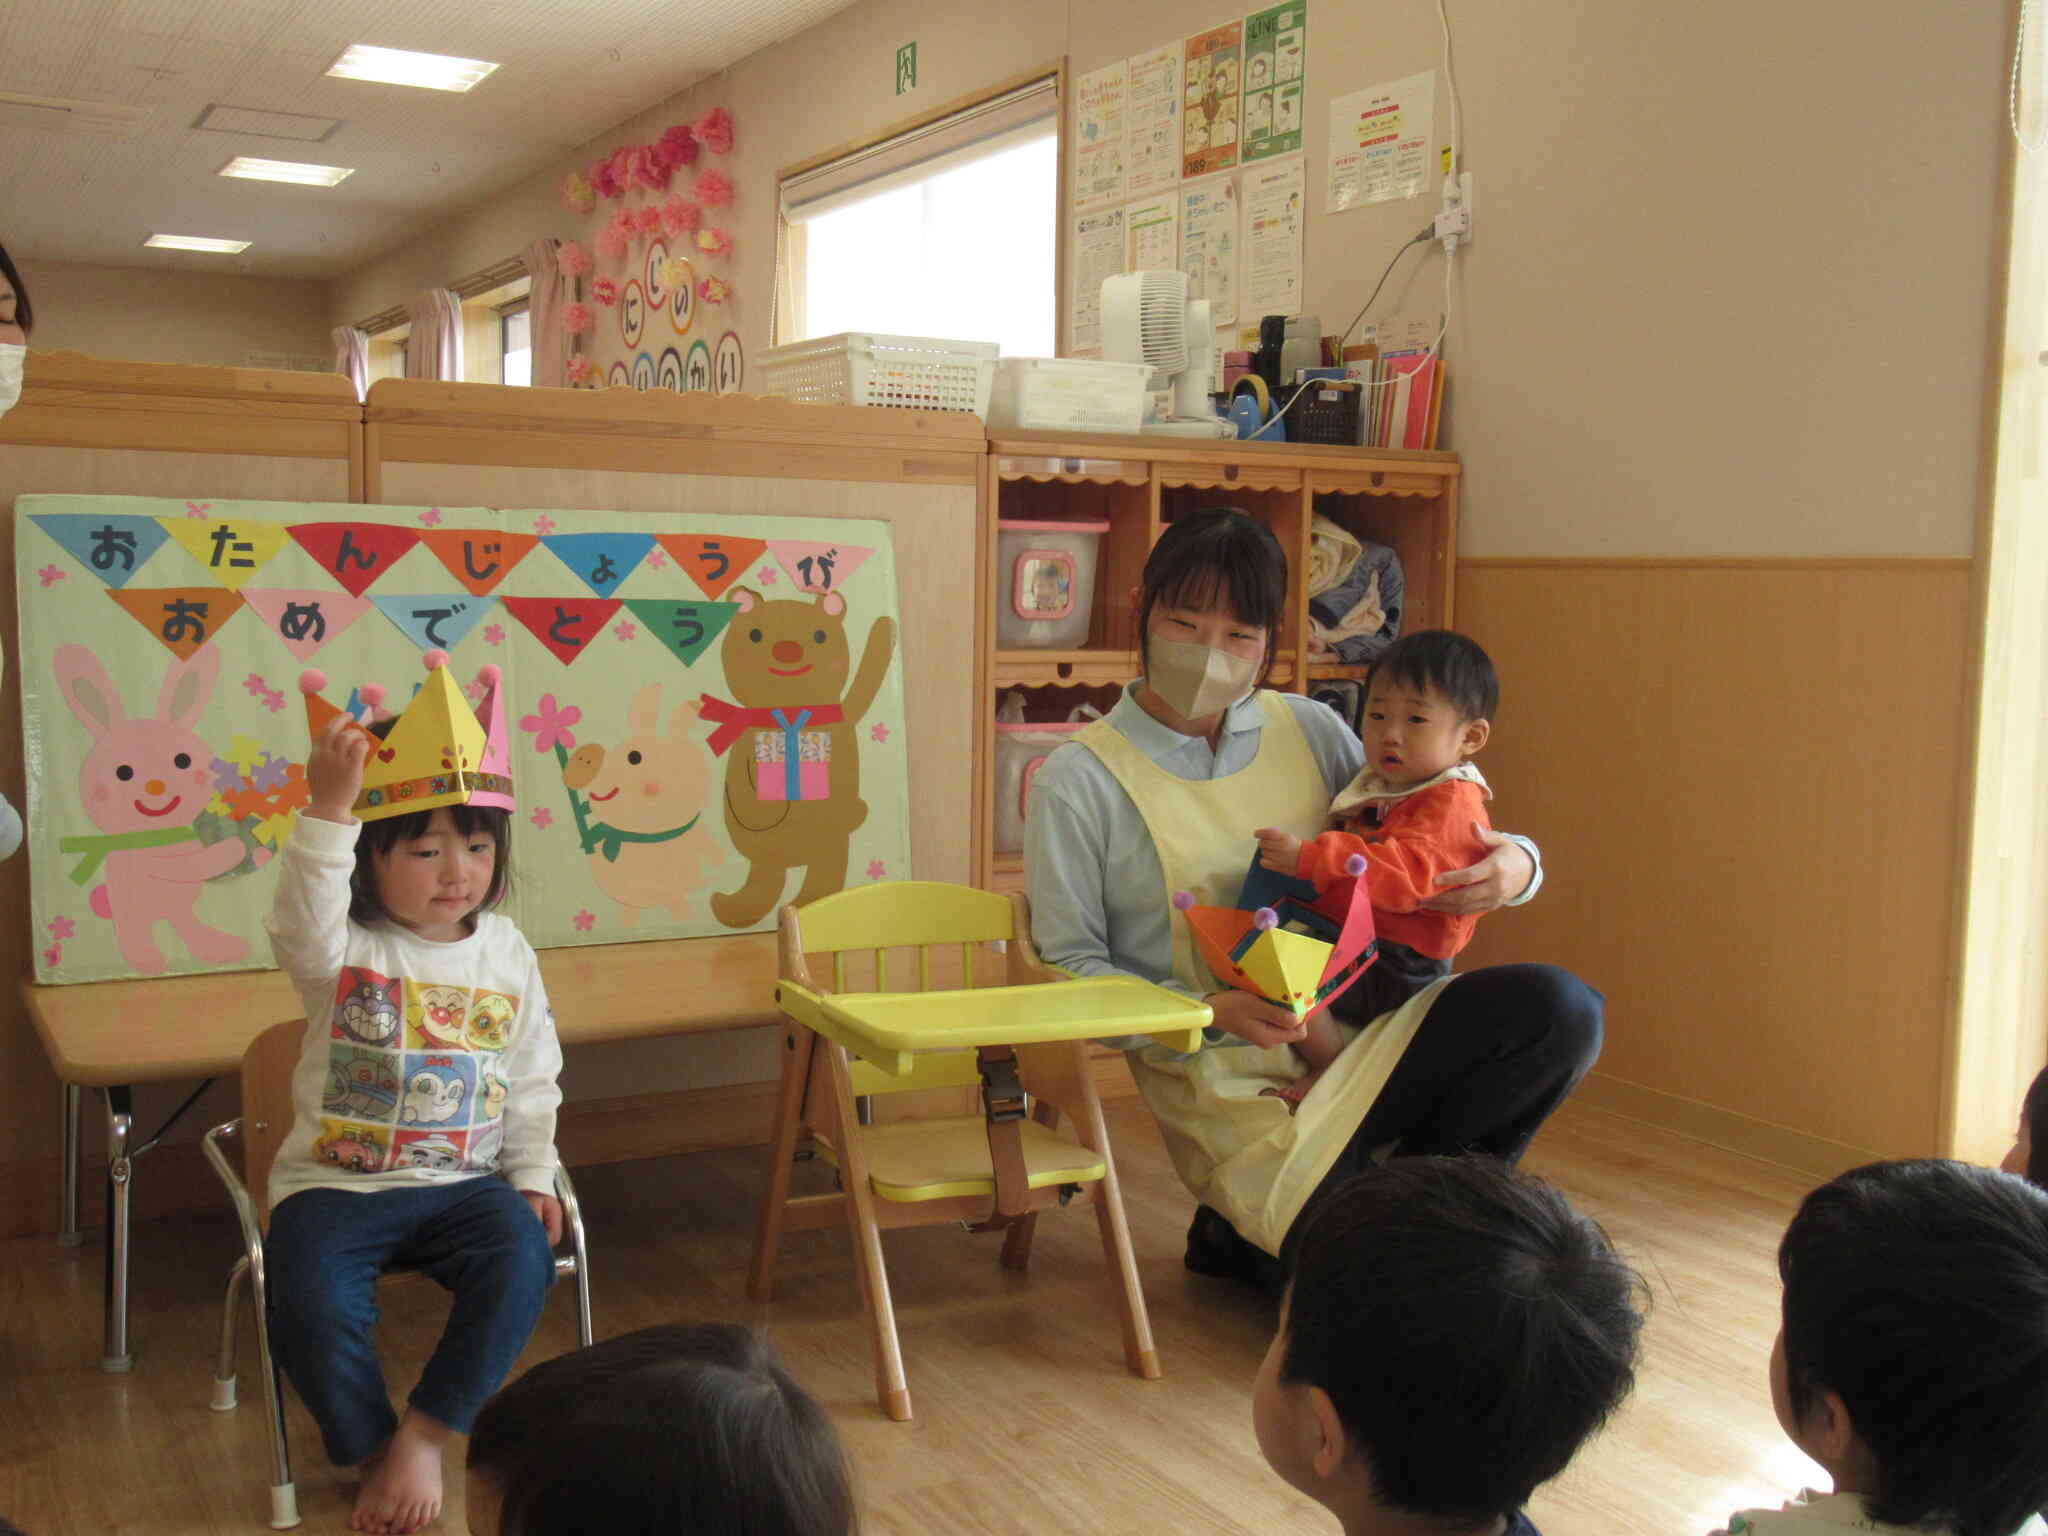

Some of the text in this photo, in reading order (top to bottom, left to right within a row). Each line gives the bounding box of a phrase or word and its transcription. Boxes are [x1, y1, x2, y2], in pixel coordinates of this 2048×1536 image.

[89, 524, 838, 590] おたんじょうび
[161, 598, 705, 648] おめでとう
